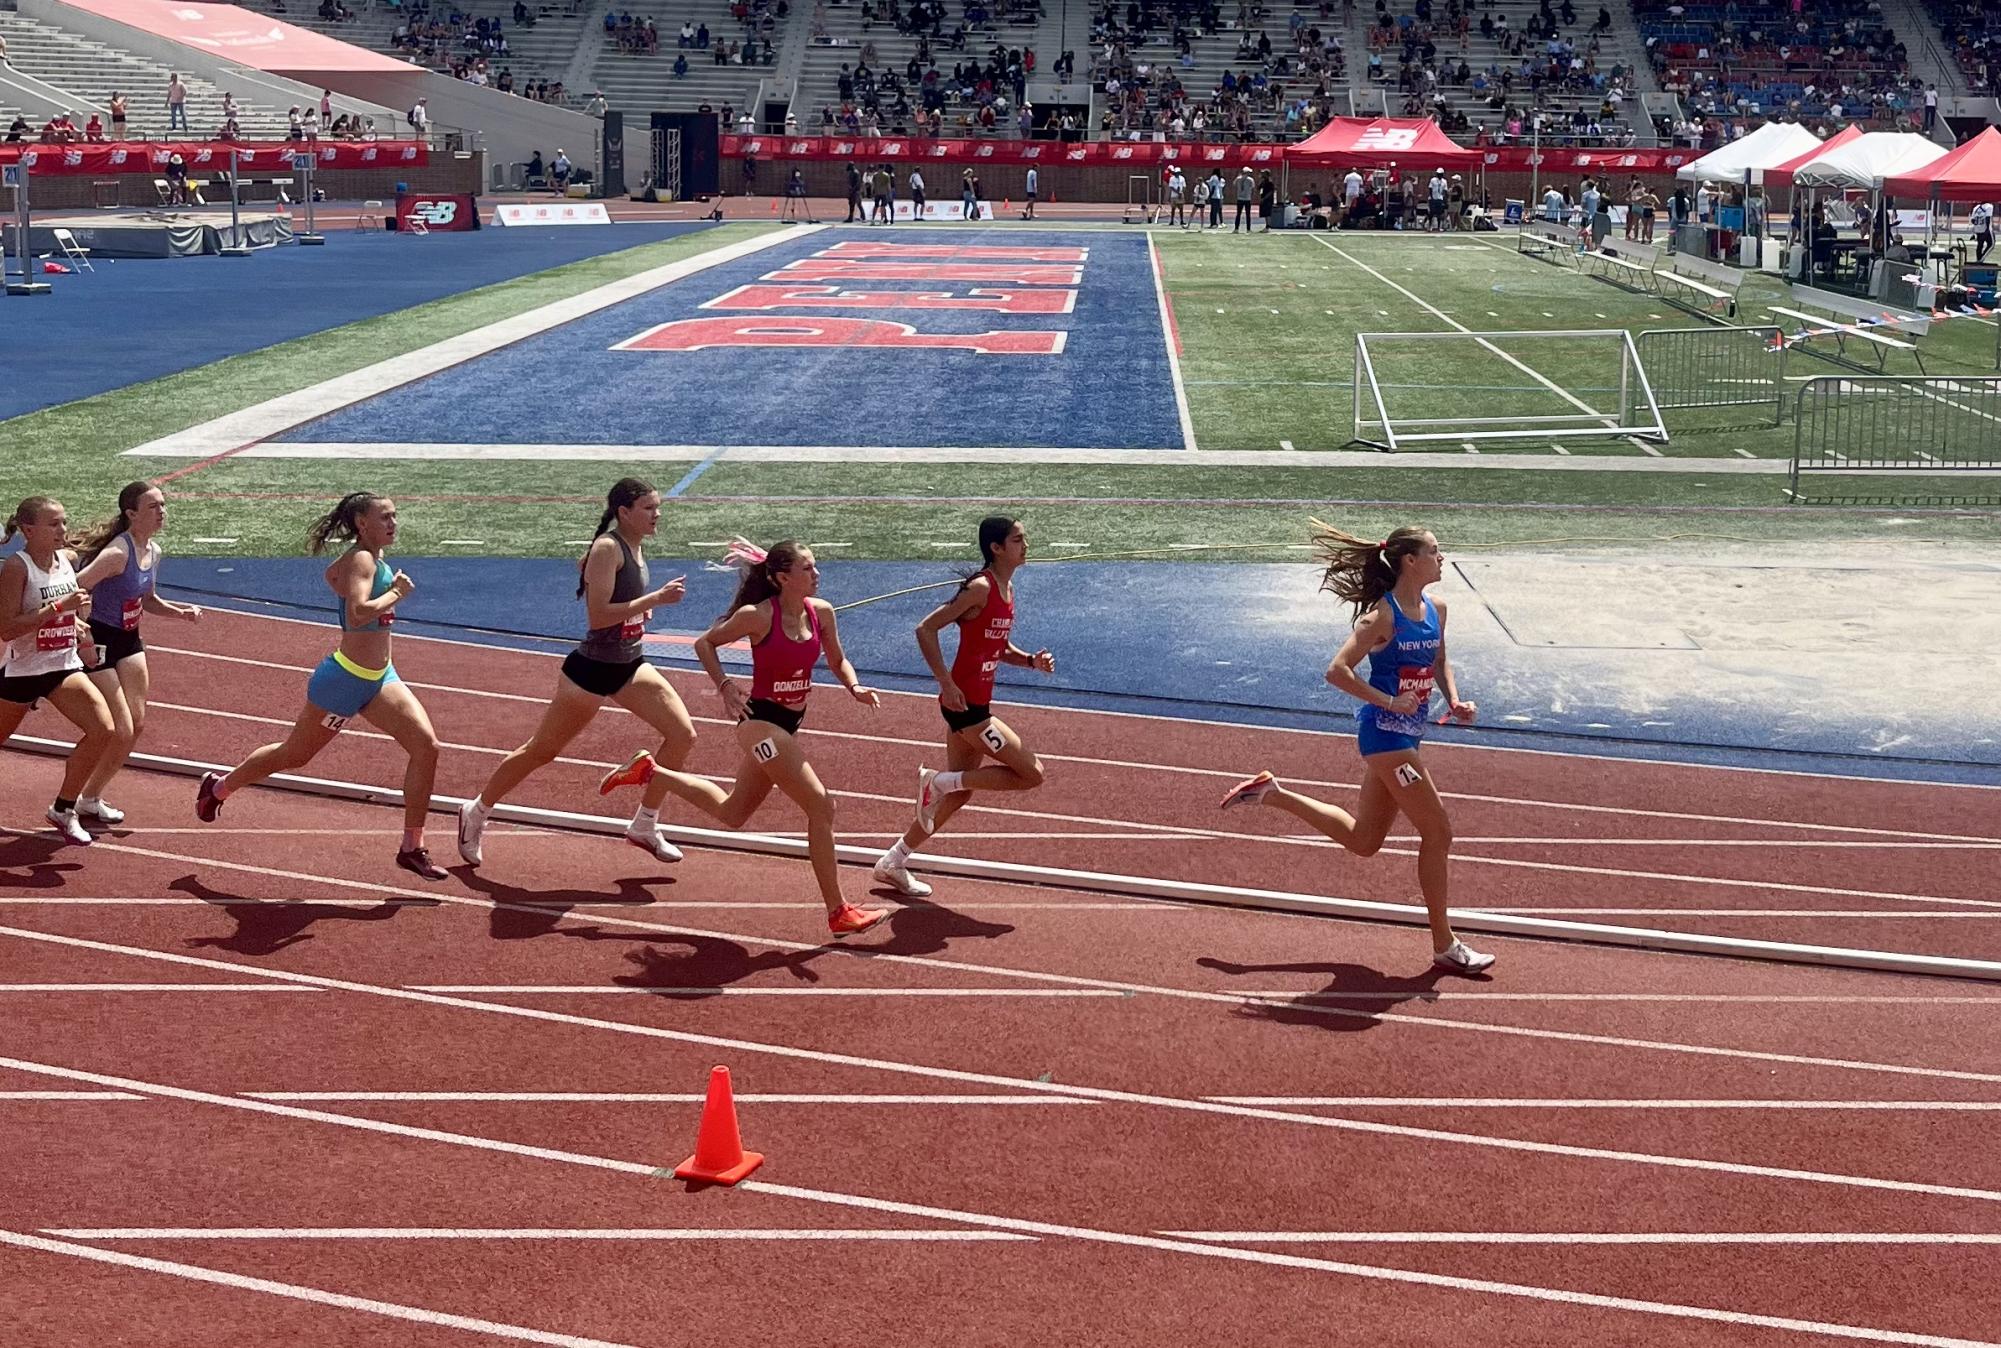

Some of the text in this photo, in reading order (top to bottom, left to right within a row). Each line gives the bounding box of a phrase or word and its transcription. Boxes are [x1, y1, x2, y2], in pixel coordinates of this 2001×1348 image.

[1350, 128, 1418, 150] NB
[606, 241, 1090, 354] PENN
[1398, 640, 1421, 651] NEW
[327, 716, 345, 729] 14
[985, 729, 1002, 750] 5
[755, 742, 773, 761] 10
